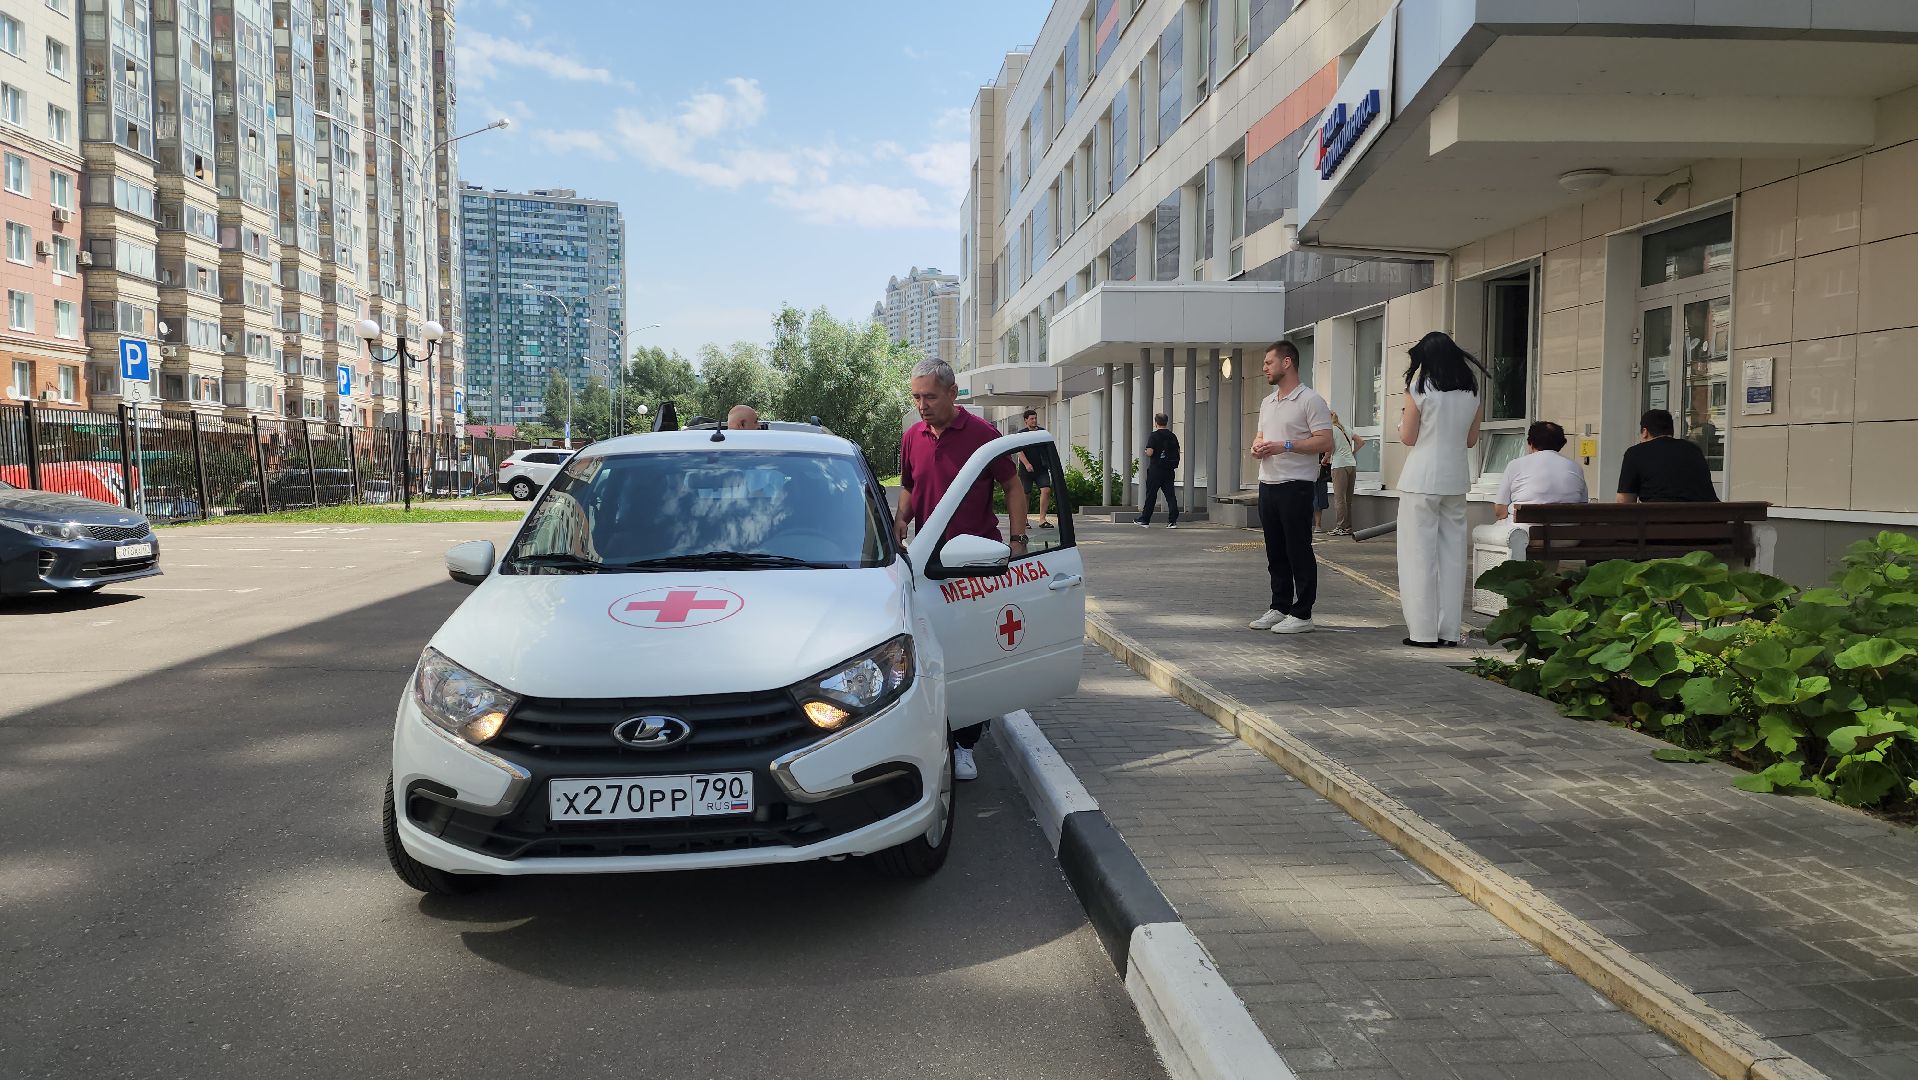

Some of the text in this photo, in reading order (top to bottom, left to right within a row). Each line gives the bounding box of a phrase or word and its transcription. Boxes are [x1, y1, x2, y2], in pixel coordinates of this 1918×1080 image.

[125, 342, 142, 376] P
[940, 560, 1050, 604] МЕДСЛУЖБА
[696, 776, 744, 802] 790
[706, 801, 730, 811] RUS
